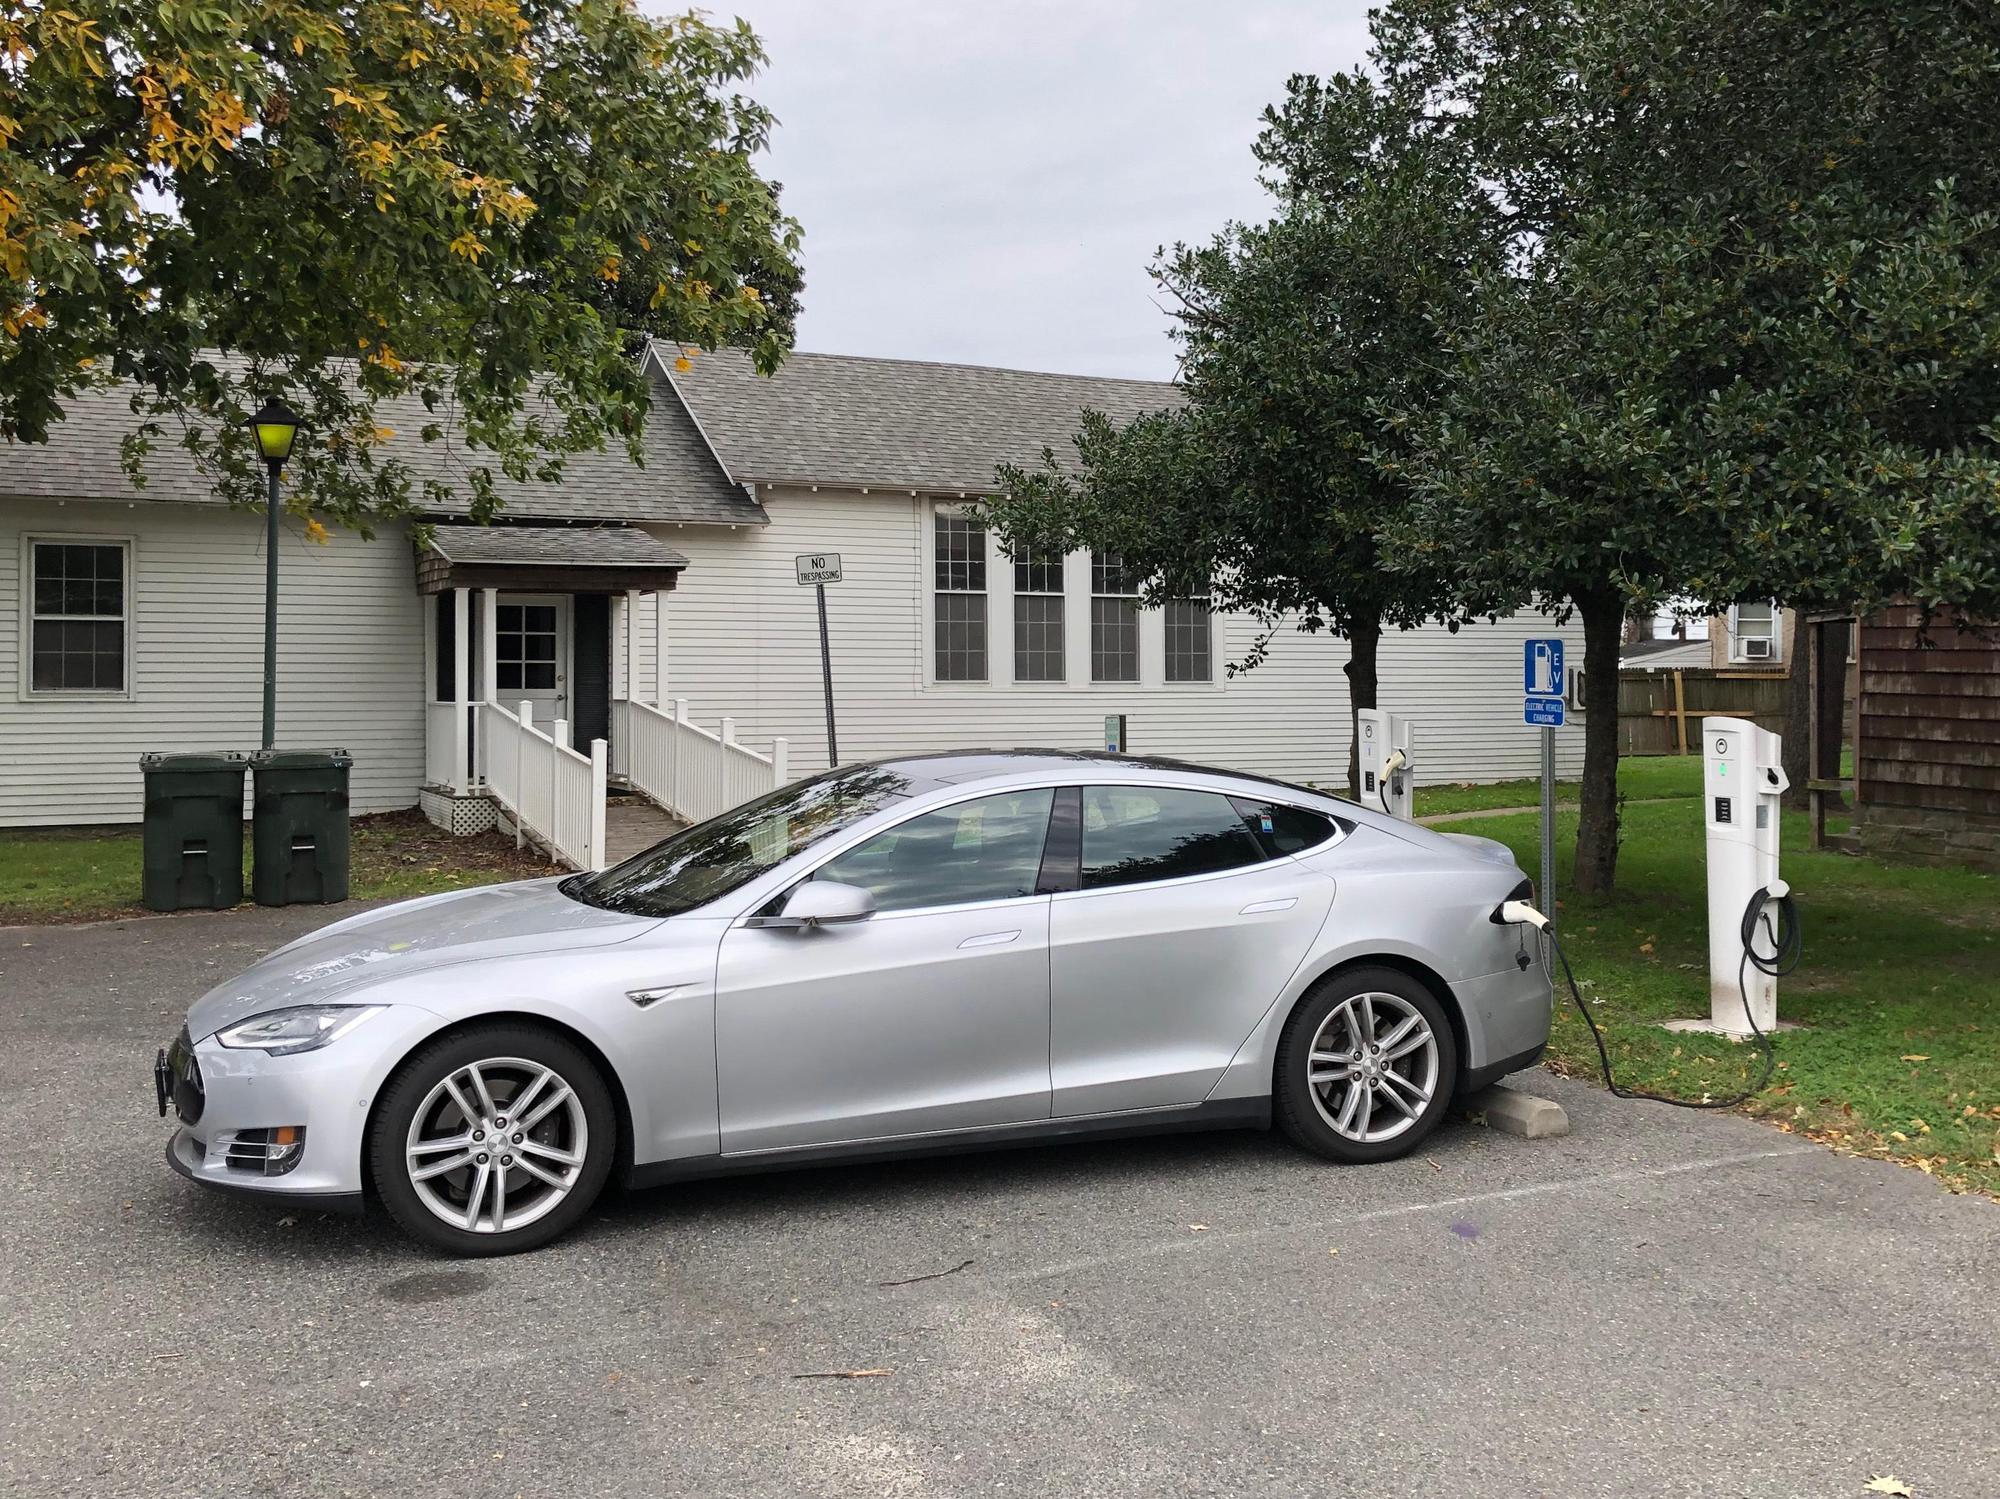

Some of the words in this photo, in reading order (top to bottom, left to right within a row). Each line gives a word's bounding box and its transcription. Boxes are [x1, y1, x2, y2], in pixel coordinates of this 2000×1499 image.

[811, 557, 826, 569] NO
[800, 570, 839, 581] TRESPASSING
[1533, 713, 1555, 723] CHARGING
